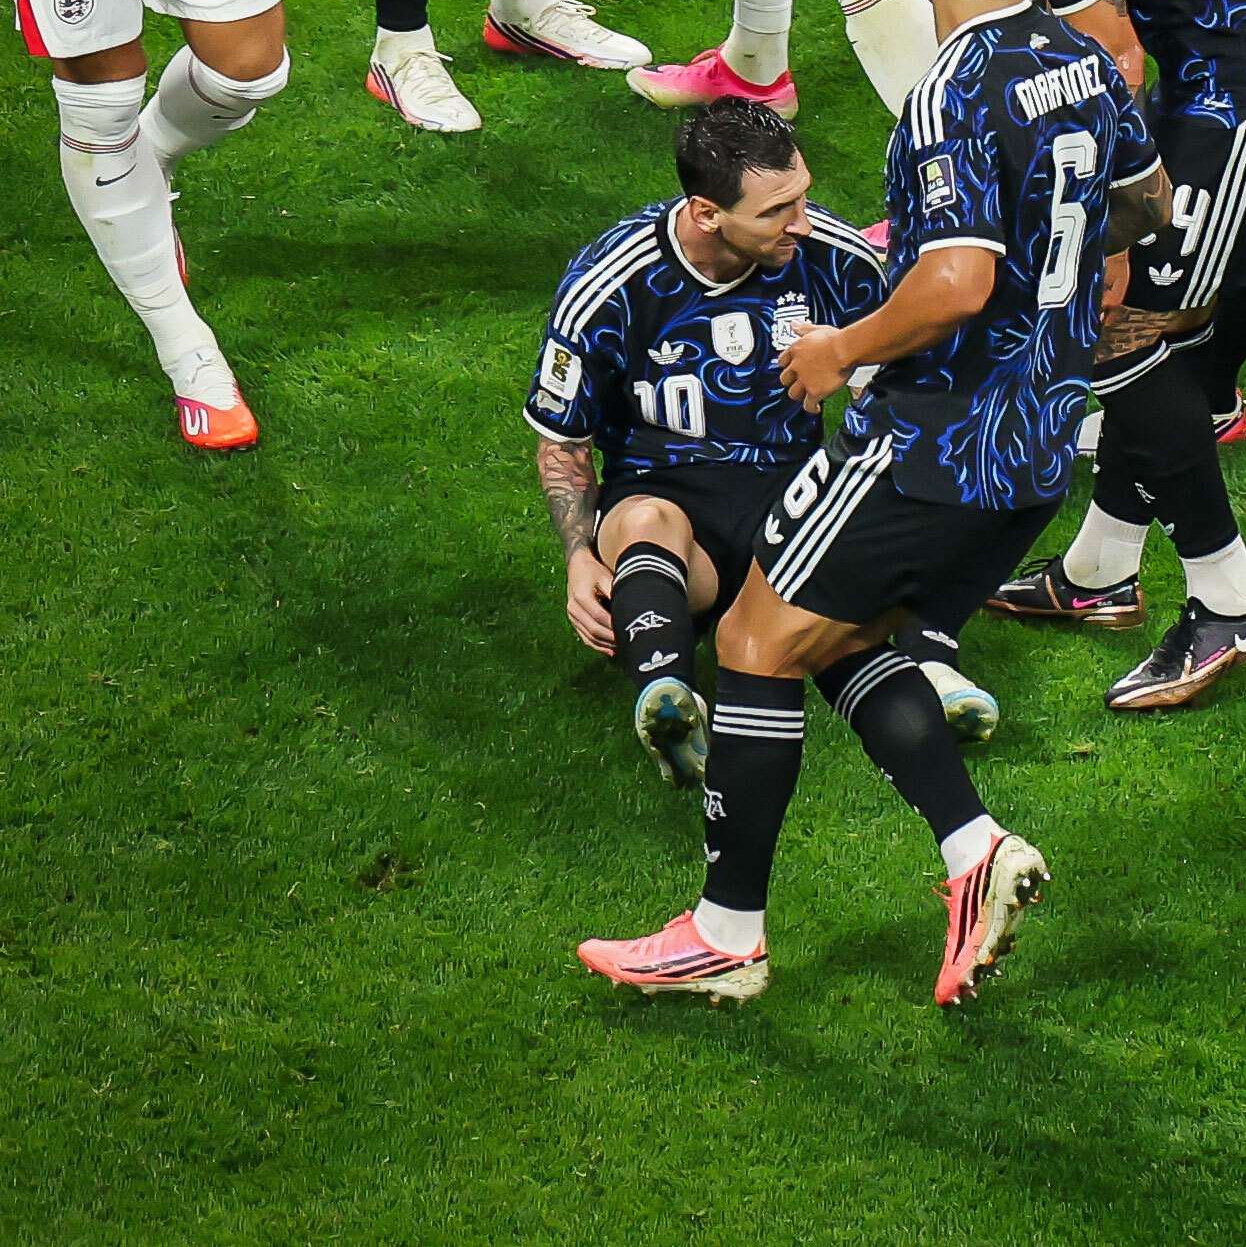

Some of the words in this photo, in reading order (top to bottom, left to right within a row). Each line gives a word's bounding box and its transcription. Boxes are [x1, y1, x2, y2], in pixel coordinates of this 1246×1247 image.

[1037, 130, 1098, 310] 6
[633, 373, 706, 439] 10
[783, 448, 829, 519] 6
